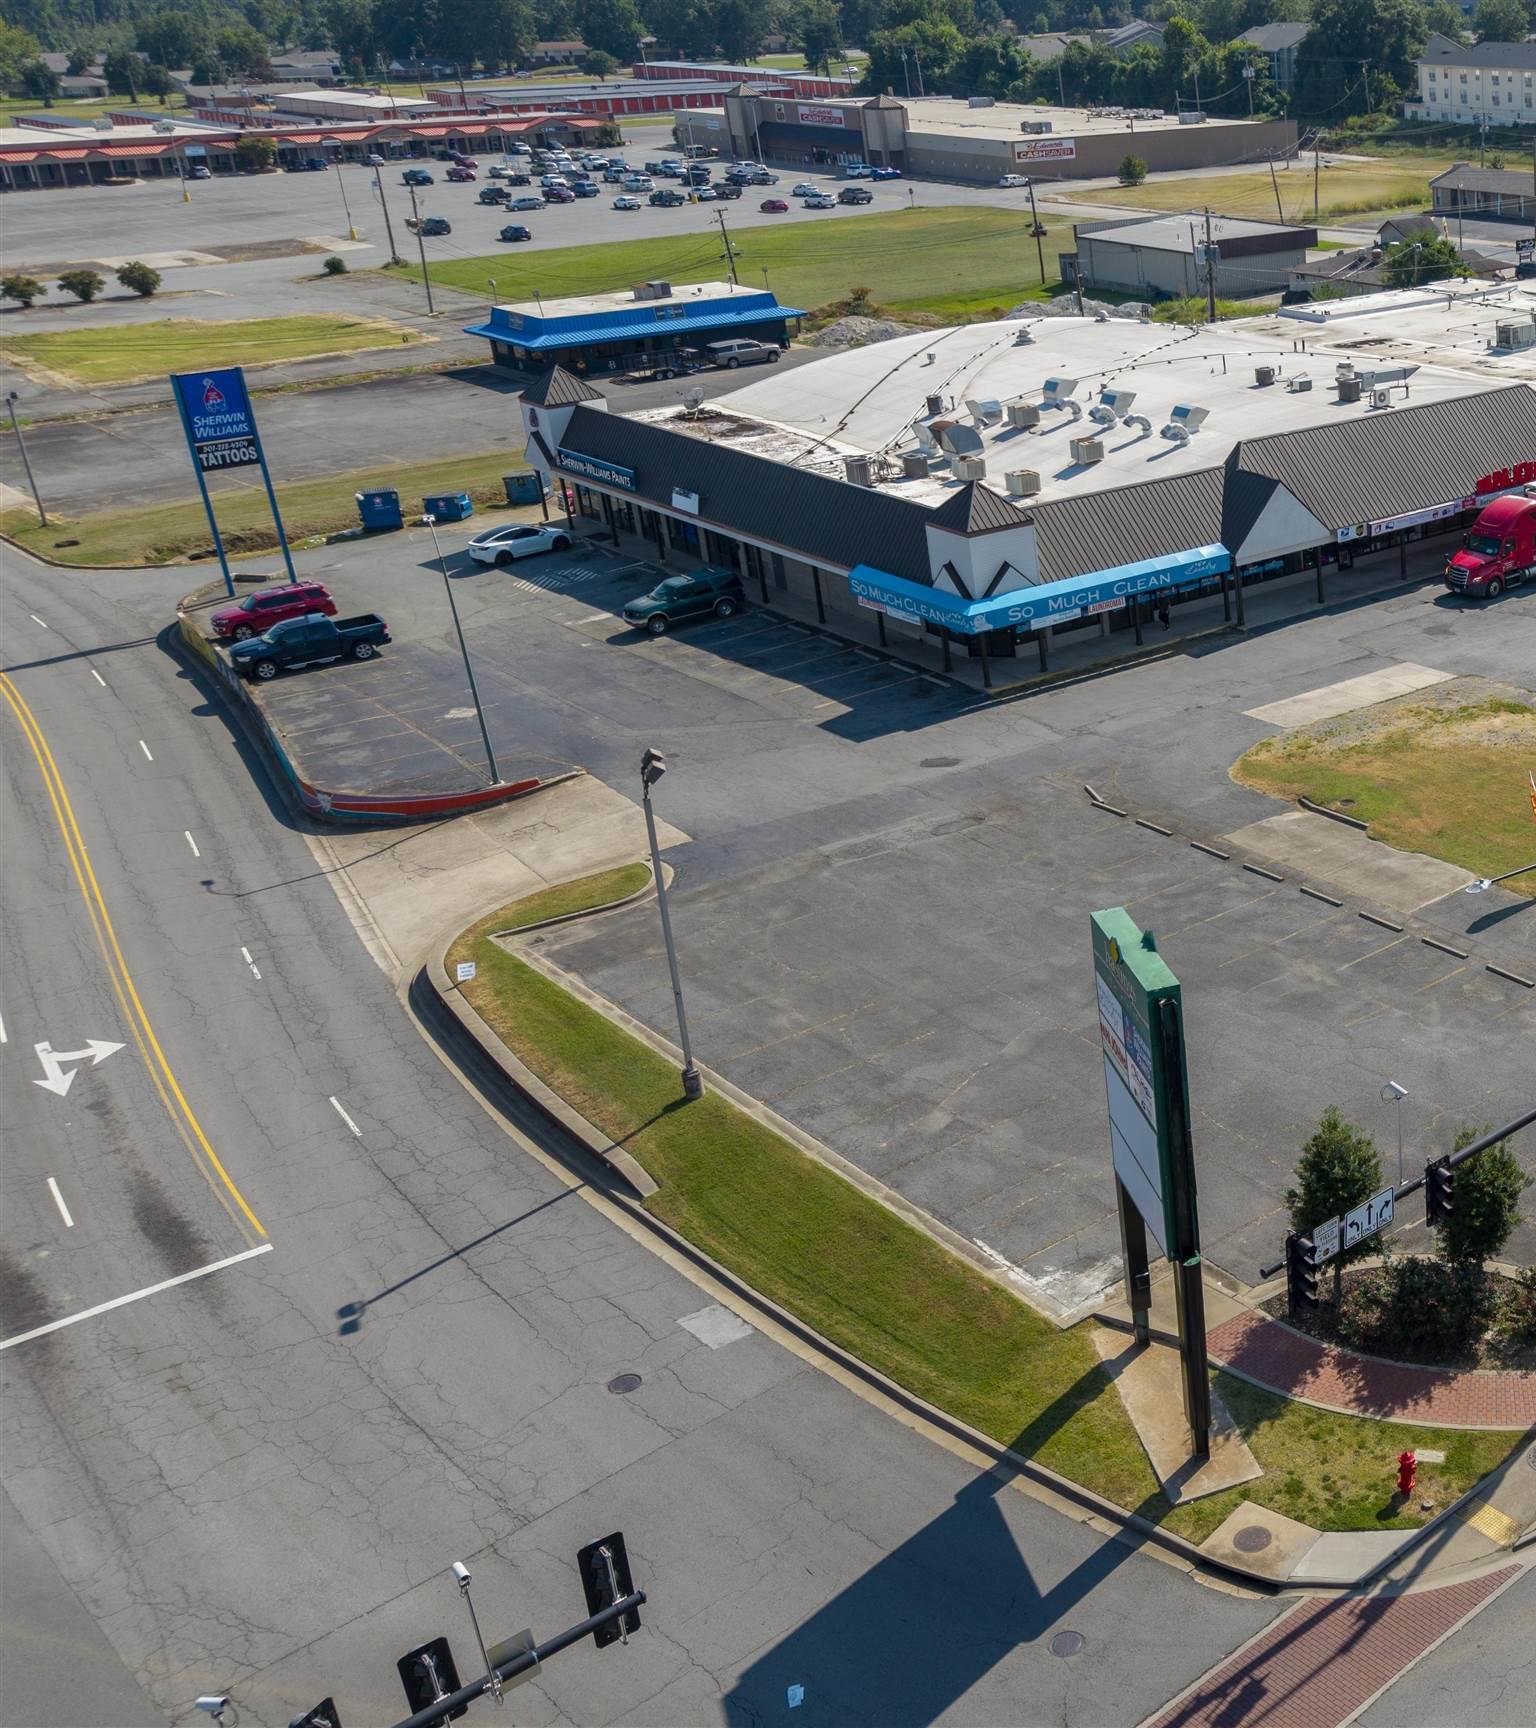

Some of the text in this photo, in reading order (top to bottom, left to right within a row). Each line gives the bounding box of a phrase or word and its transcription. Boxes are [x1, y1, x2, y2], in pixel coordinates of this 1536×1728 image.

[193, 412, 246, 428] SHERWIN
[195, 423, 249, 438] WILLIAMS
[199, 447, 257, 467] TATTOOS
[611, 471, 631, 487] PAINTS
[851, 579, 868, 596] SO
[868, 586, 902, 608] MUCH
[904, 598, 945, 623] CLEAN
[1007, 606, 1034, 622] SO
[1048, 590, 1100, 612] MUCH
[1112, 572, 1171, 596] CLEAN
